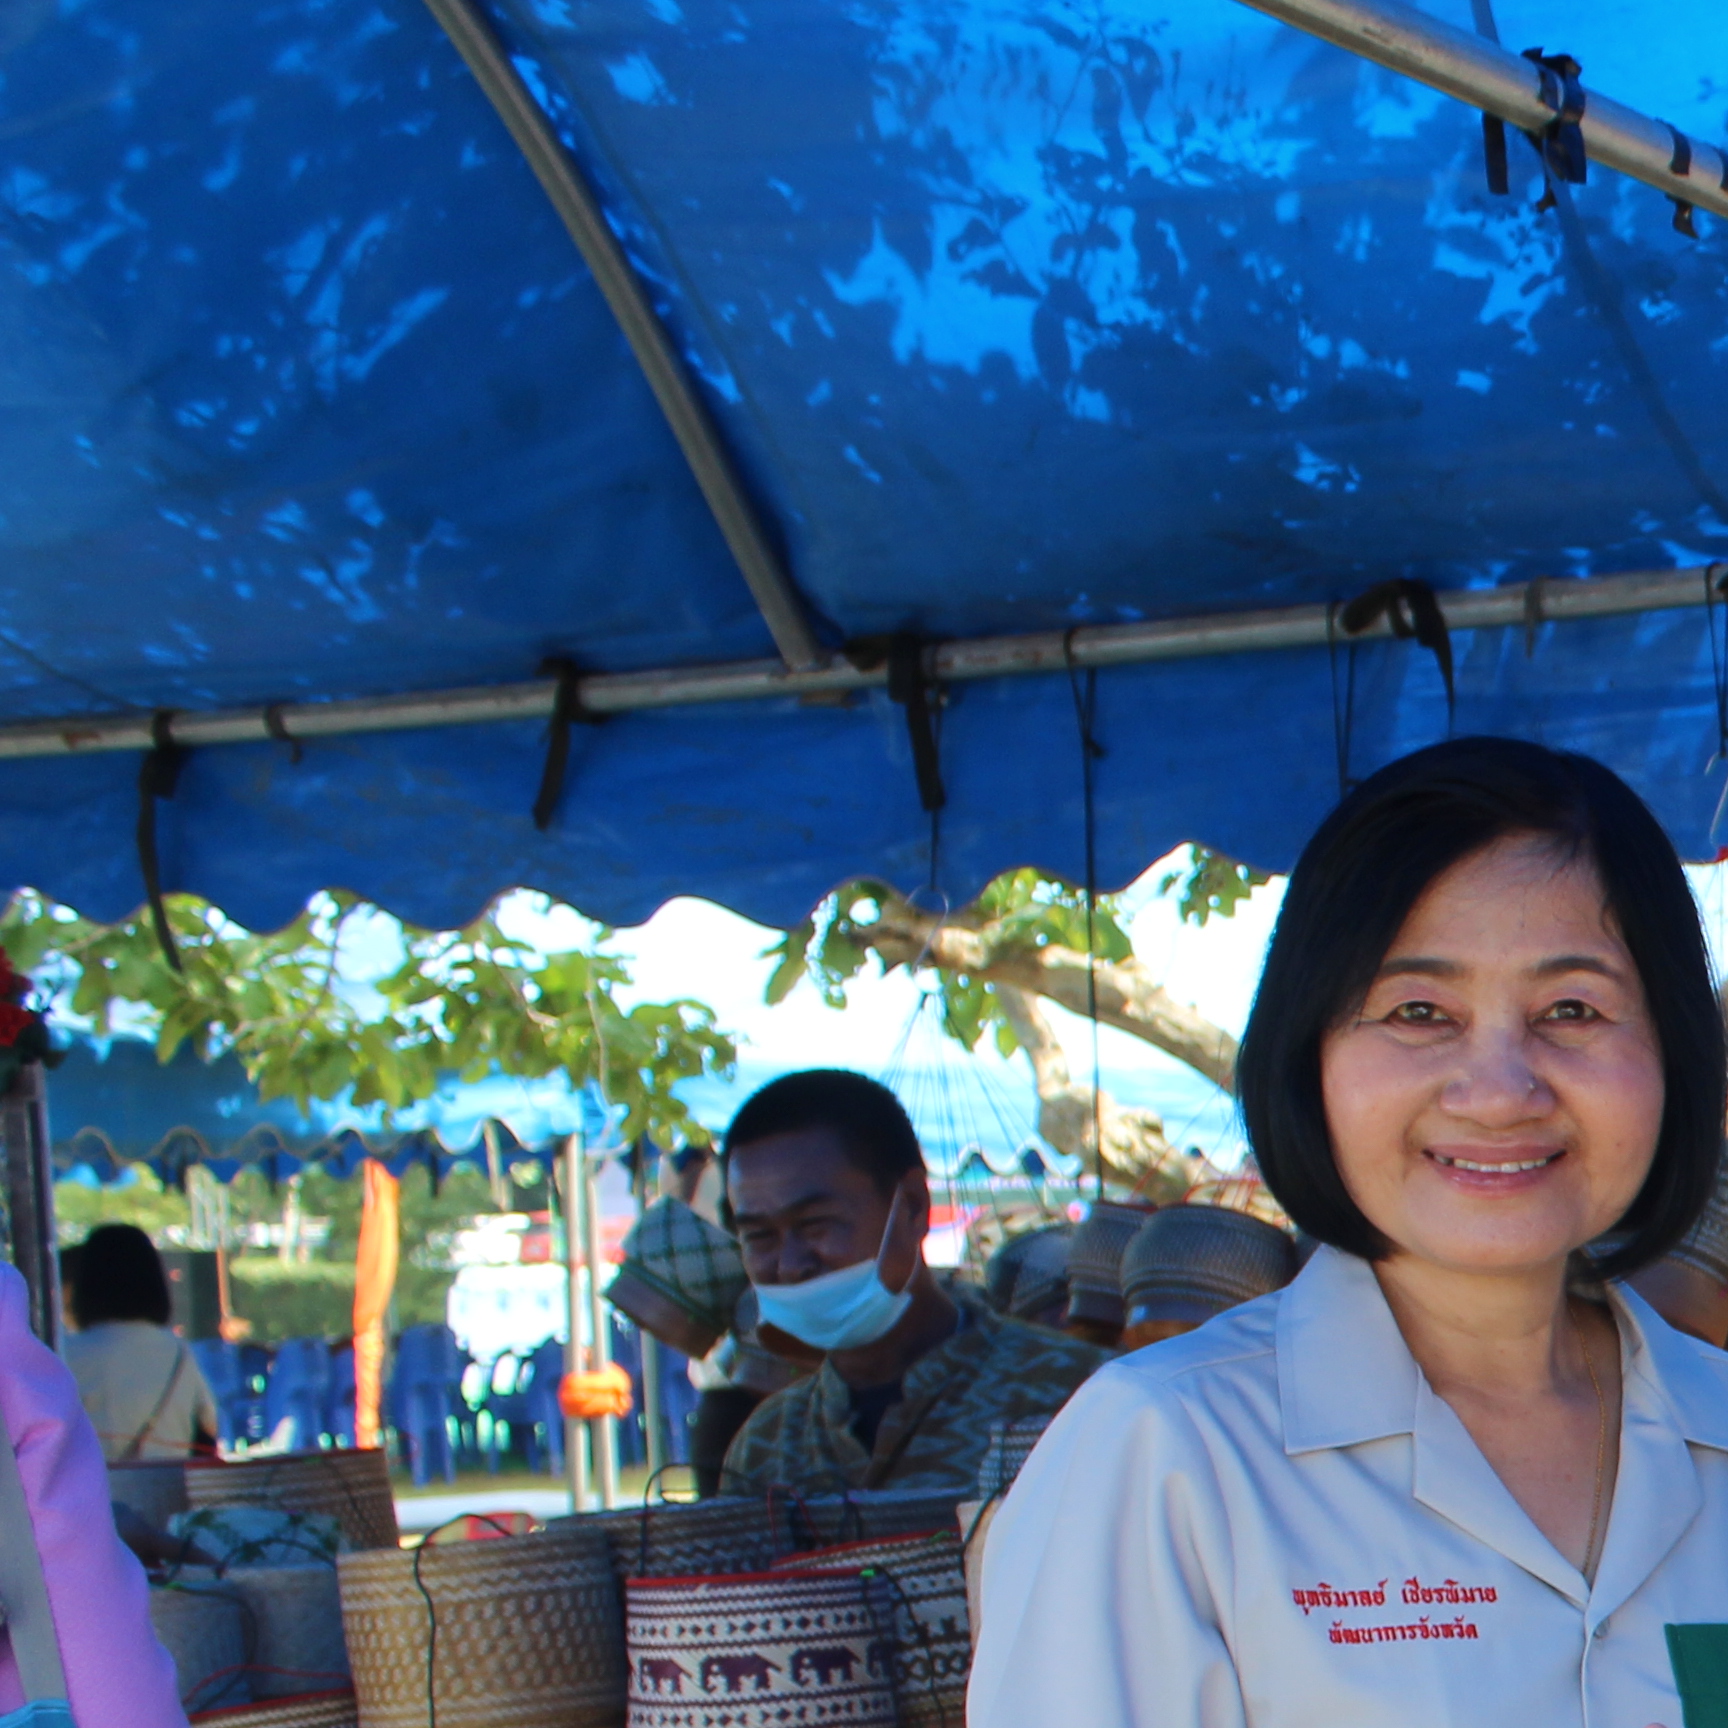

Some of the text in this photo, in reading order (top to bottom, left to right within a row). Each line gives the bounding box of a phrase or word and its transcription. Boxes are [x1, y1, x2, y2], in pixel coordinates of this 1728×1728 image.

[1328, 1615, 1479, 1645] พัฒนาการจังหวัด
